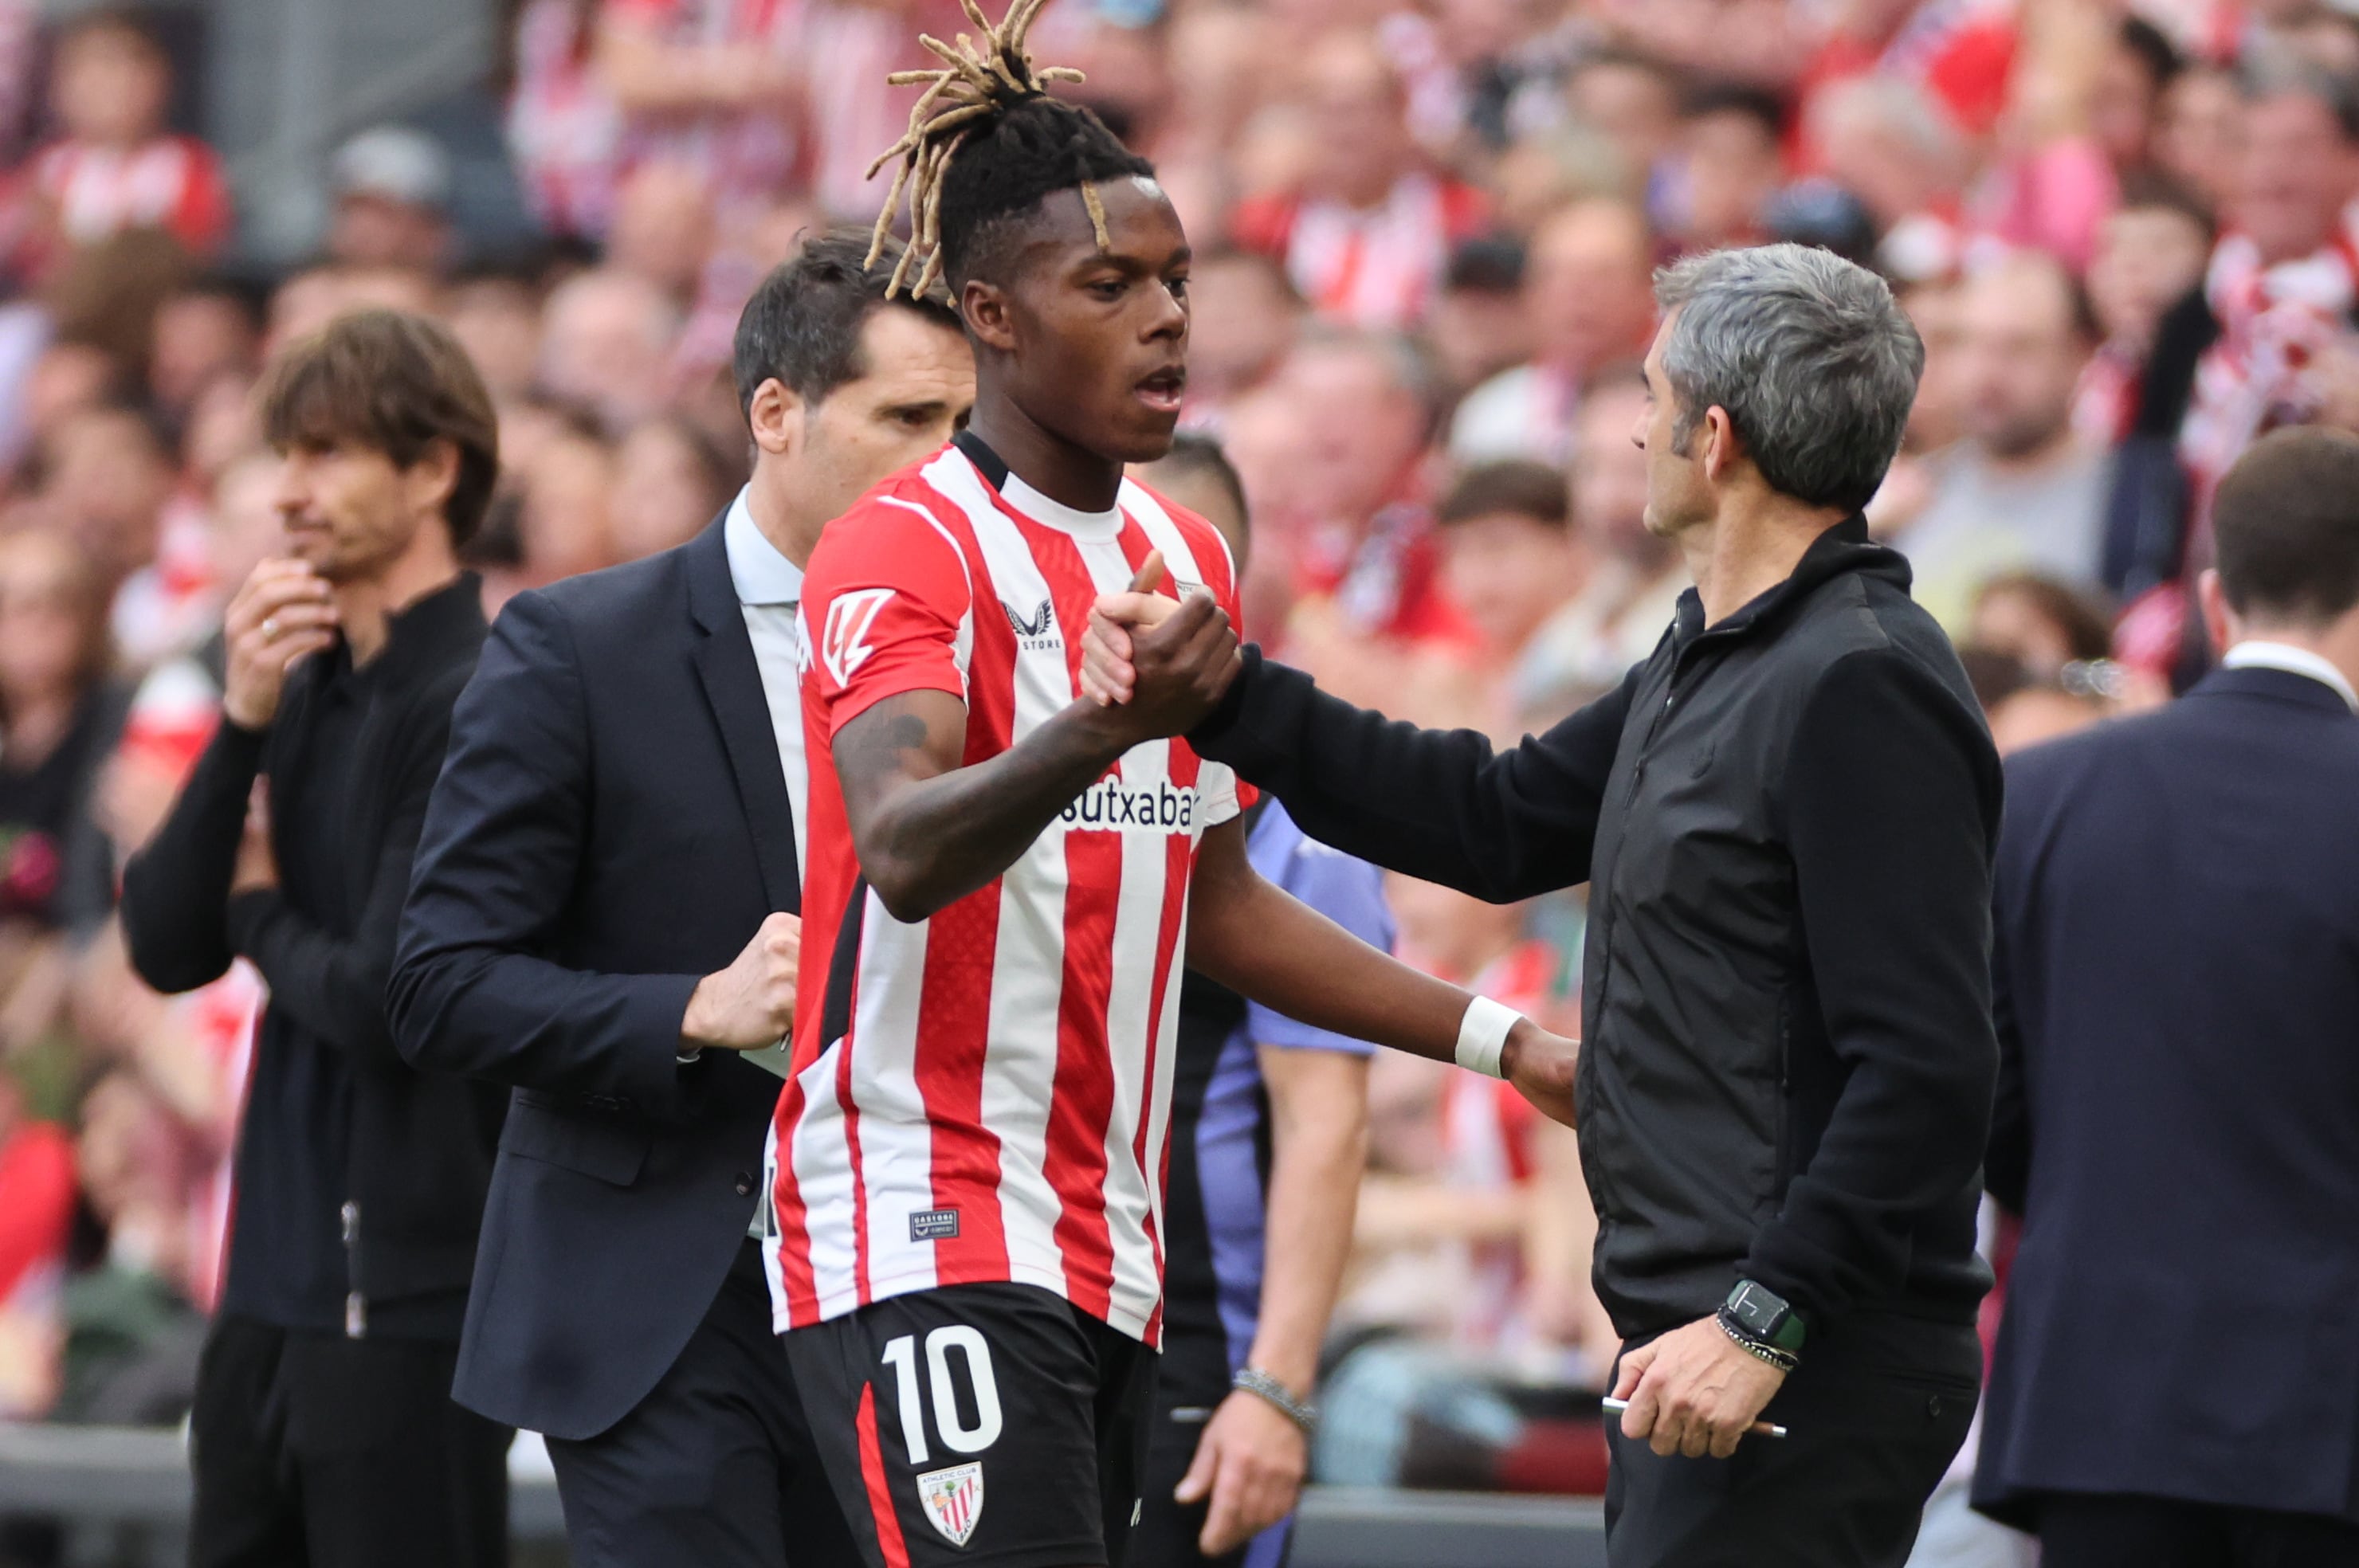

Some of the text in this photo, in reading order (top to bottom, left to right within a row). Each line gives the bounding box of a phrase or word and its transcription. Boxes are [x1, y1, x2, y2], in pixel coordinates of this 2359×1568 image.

[1061, 781, 1200, 827] utxaba
[881, 1324, 1003, 1464] 10
[923, 1466, 977, 1484] ATHLETIC CLUB
[944, 1519, 971, 1543] BILBAO
